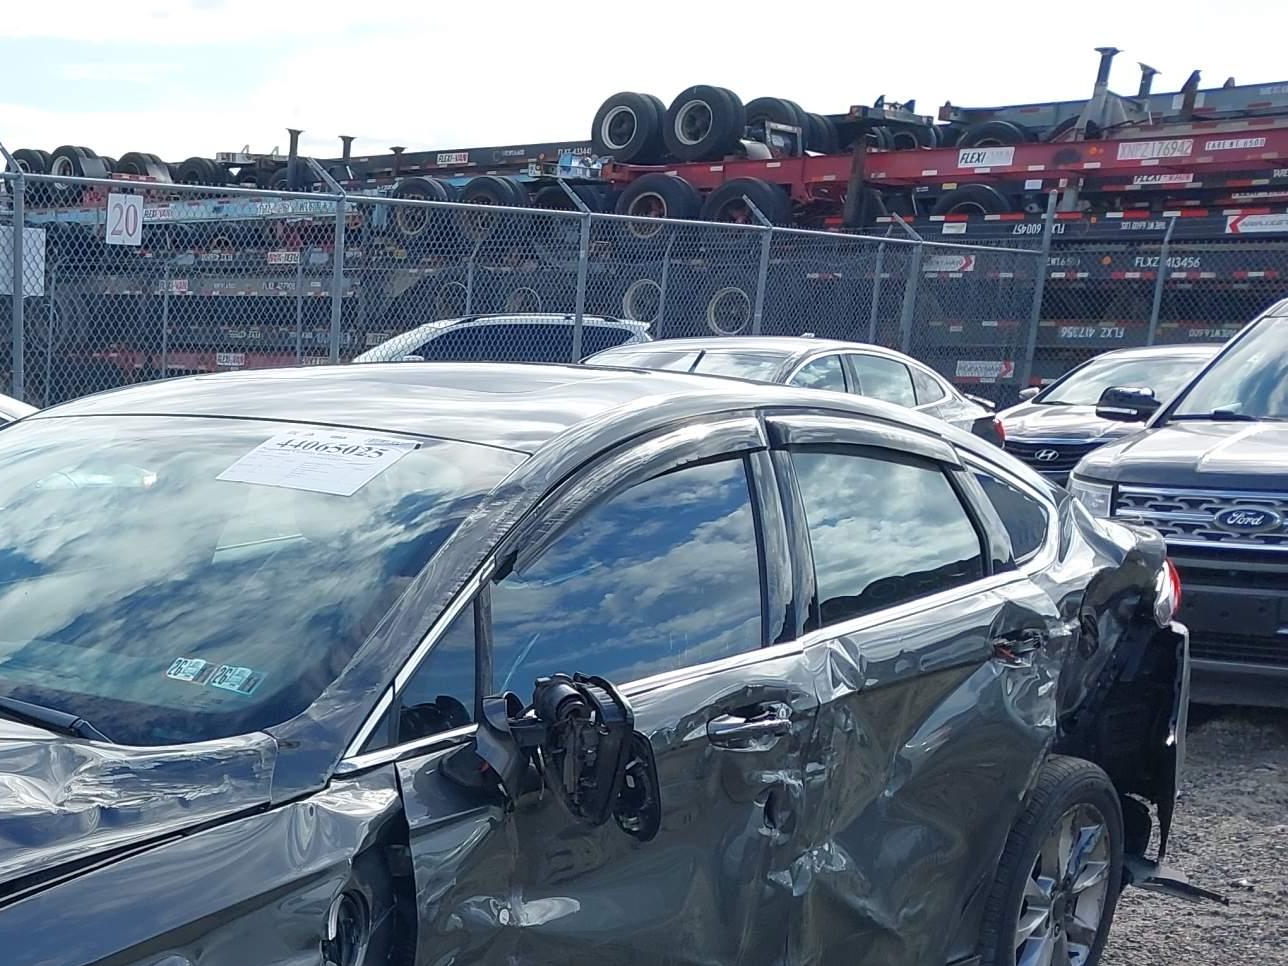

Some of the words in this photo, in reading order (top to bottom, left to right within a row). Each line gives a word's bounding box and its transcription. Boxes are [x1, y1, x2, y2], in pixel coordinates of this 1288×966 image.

[110, 203, 138, 237] 20
[1134, 256, 1160, 268] FLXZ
[1166, 256, 1201, 268] 413456
[1099, 326, 1125, 338] FLXZ
[276, 437, 390, 459] 44065025
[1226, 510, 1264, 526] Ford
